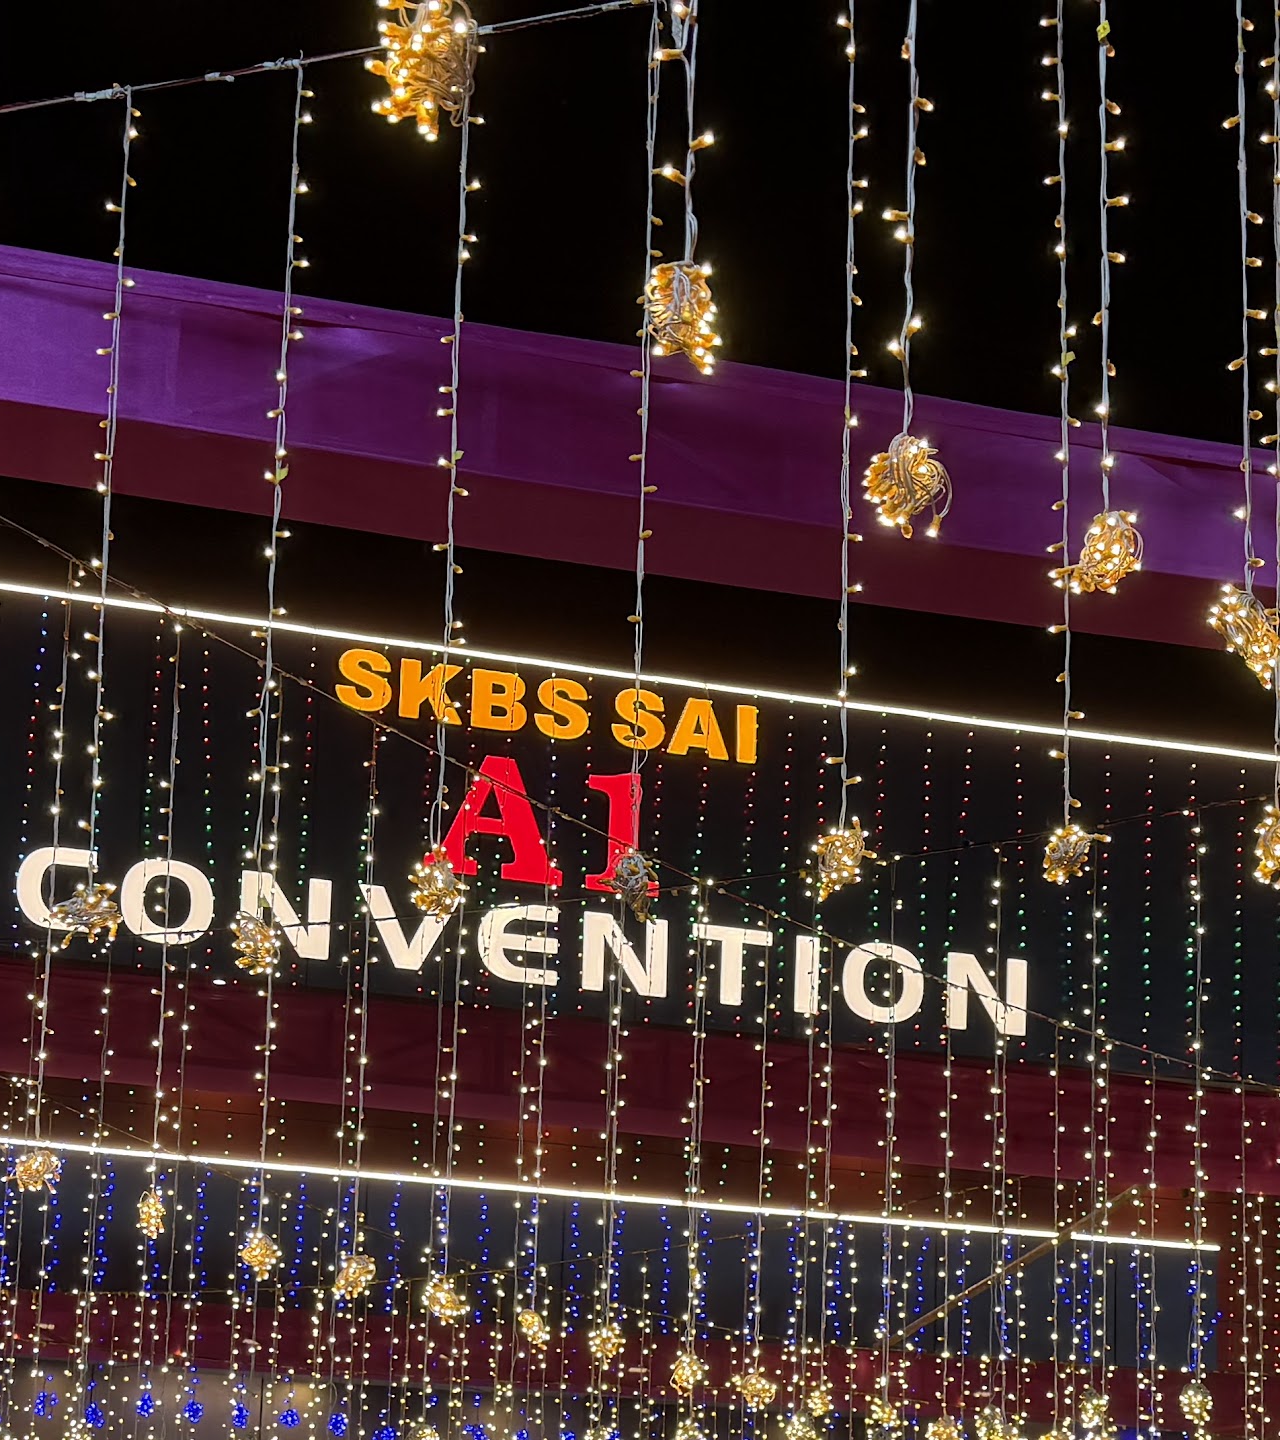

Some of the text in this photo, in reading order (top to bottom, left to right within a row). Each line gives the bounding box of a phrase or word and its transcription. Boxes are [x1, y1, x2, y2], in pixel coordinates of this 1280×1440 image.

[335, 648, 758, 765] SKBS SAI
[16, 846, 1028, 1037] CONVENTION
